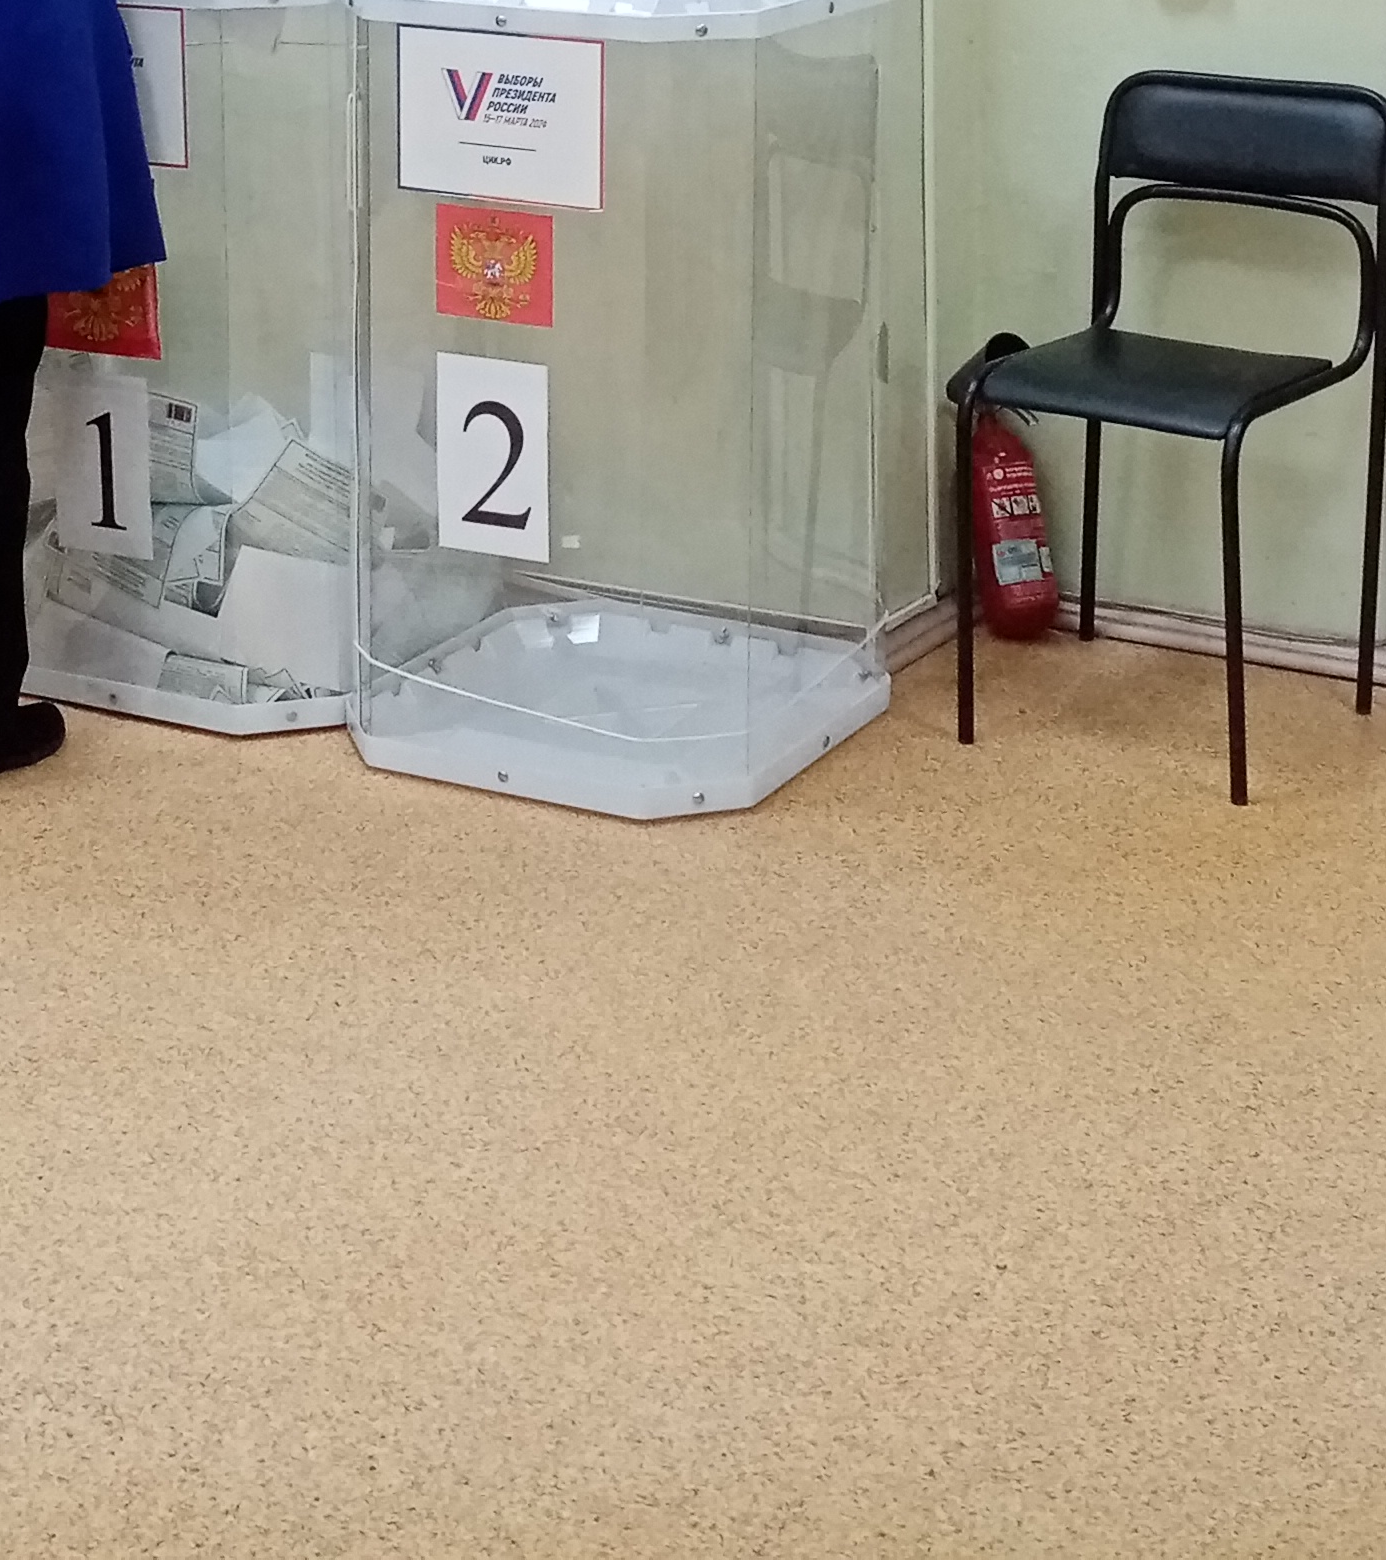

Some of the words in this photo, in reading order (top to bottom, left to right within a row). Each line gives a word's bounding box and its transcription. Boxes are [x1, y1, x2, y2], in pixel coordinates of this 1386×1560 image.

[497, 73, 544, 88] ВЫБОРЫ
[492, 87, 557, 103] ПРЕЗИДЕНТА
[486, 100, 529, 115] РОССИИ
[503, 116, 529, 126] МАРТА
[86, 412, 127, 531] 1
[461, 400, 532, 530] 2
